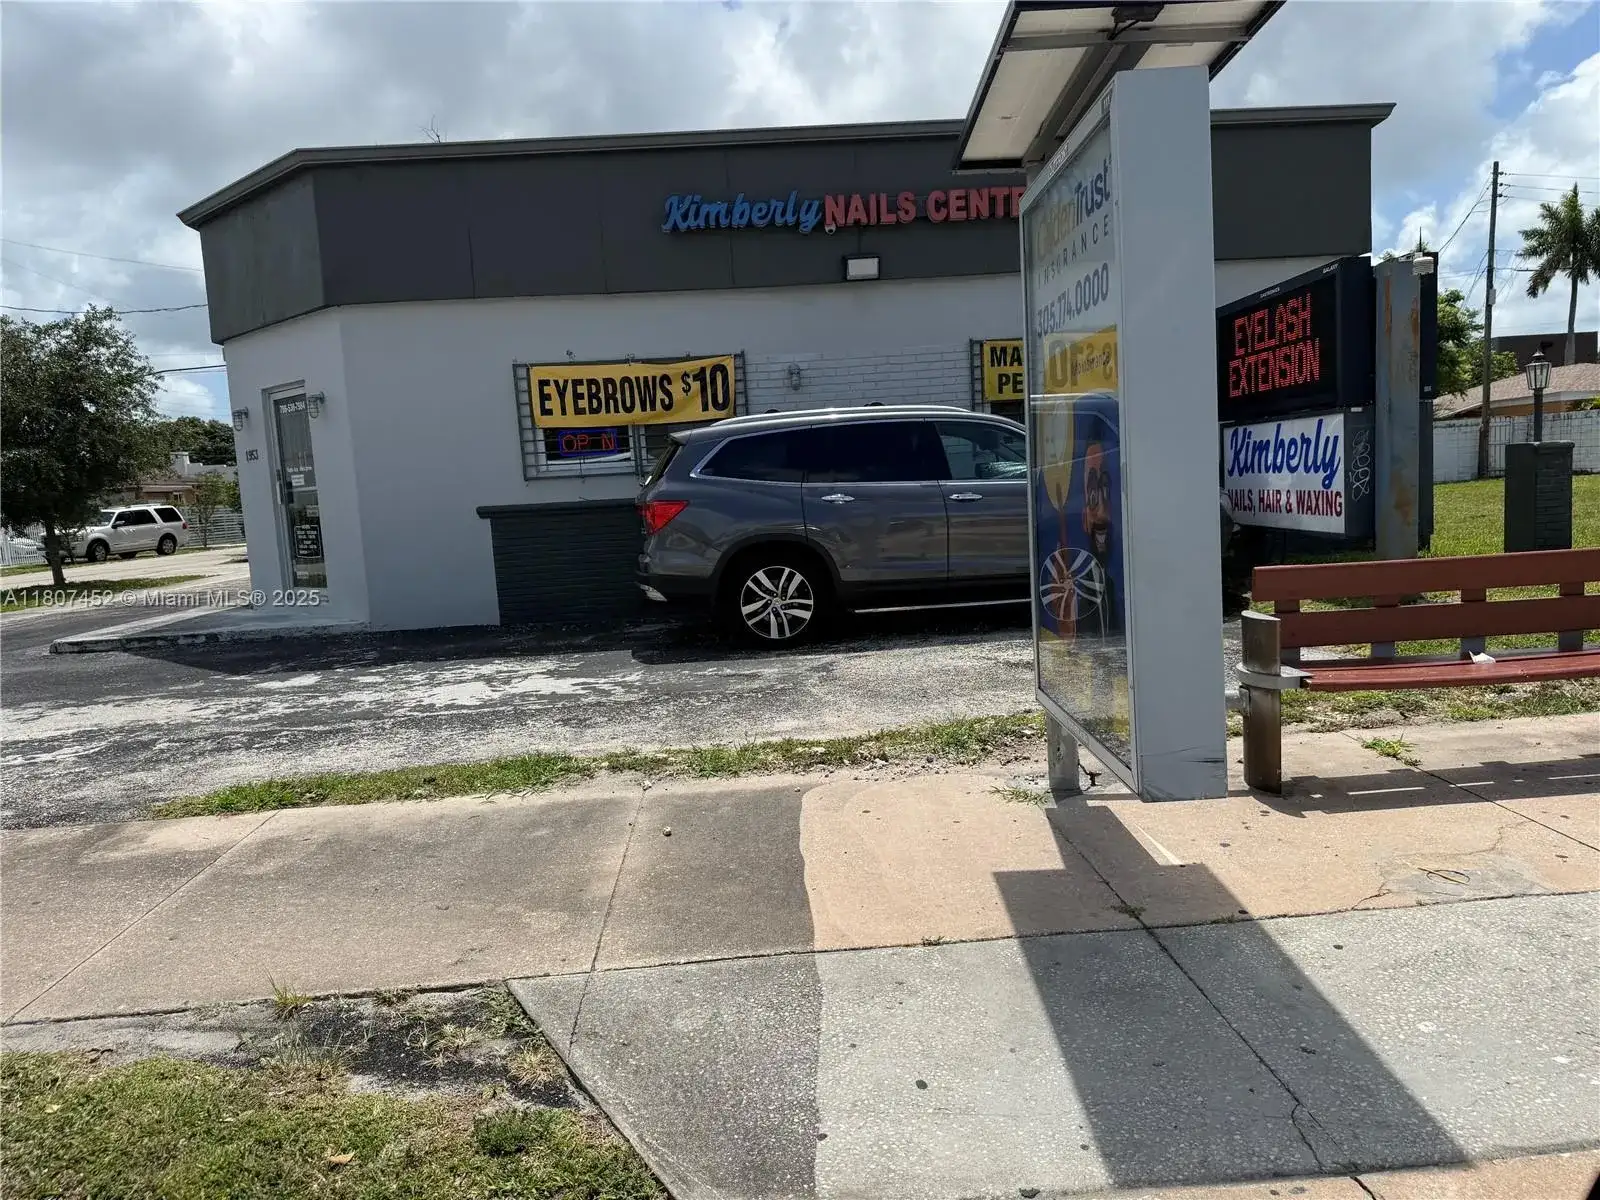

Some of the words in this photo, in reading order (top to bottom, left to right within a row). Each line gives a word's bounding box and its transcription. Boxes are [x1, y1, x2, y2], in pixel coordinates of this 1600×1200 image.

[660, 190, 822, 234] Kimberly
[824, 190, 917, 228] NAILS
[1037, 213, 1109, 290] INSURANCE
[1036, 262, 1109, 338] 305.774.0000
[1234, 293, 1312, 357] EYELASH
[537, 375, 674, 416] EYEBROWS
[680, 363, 730, 412] $10
[1228, 337, 1320, 398] EXTENSION
[1227, 418, 1341, 489] Kimberly
[1258, 489, 1283, 513] HAIR
[1285, 490, 1293, 514] &
[1296, 490, 1343, 517] WAXING
